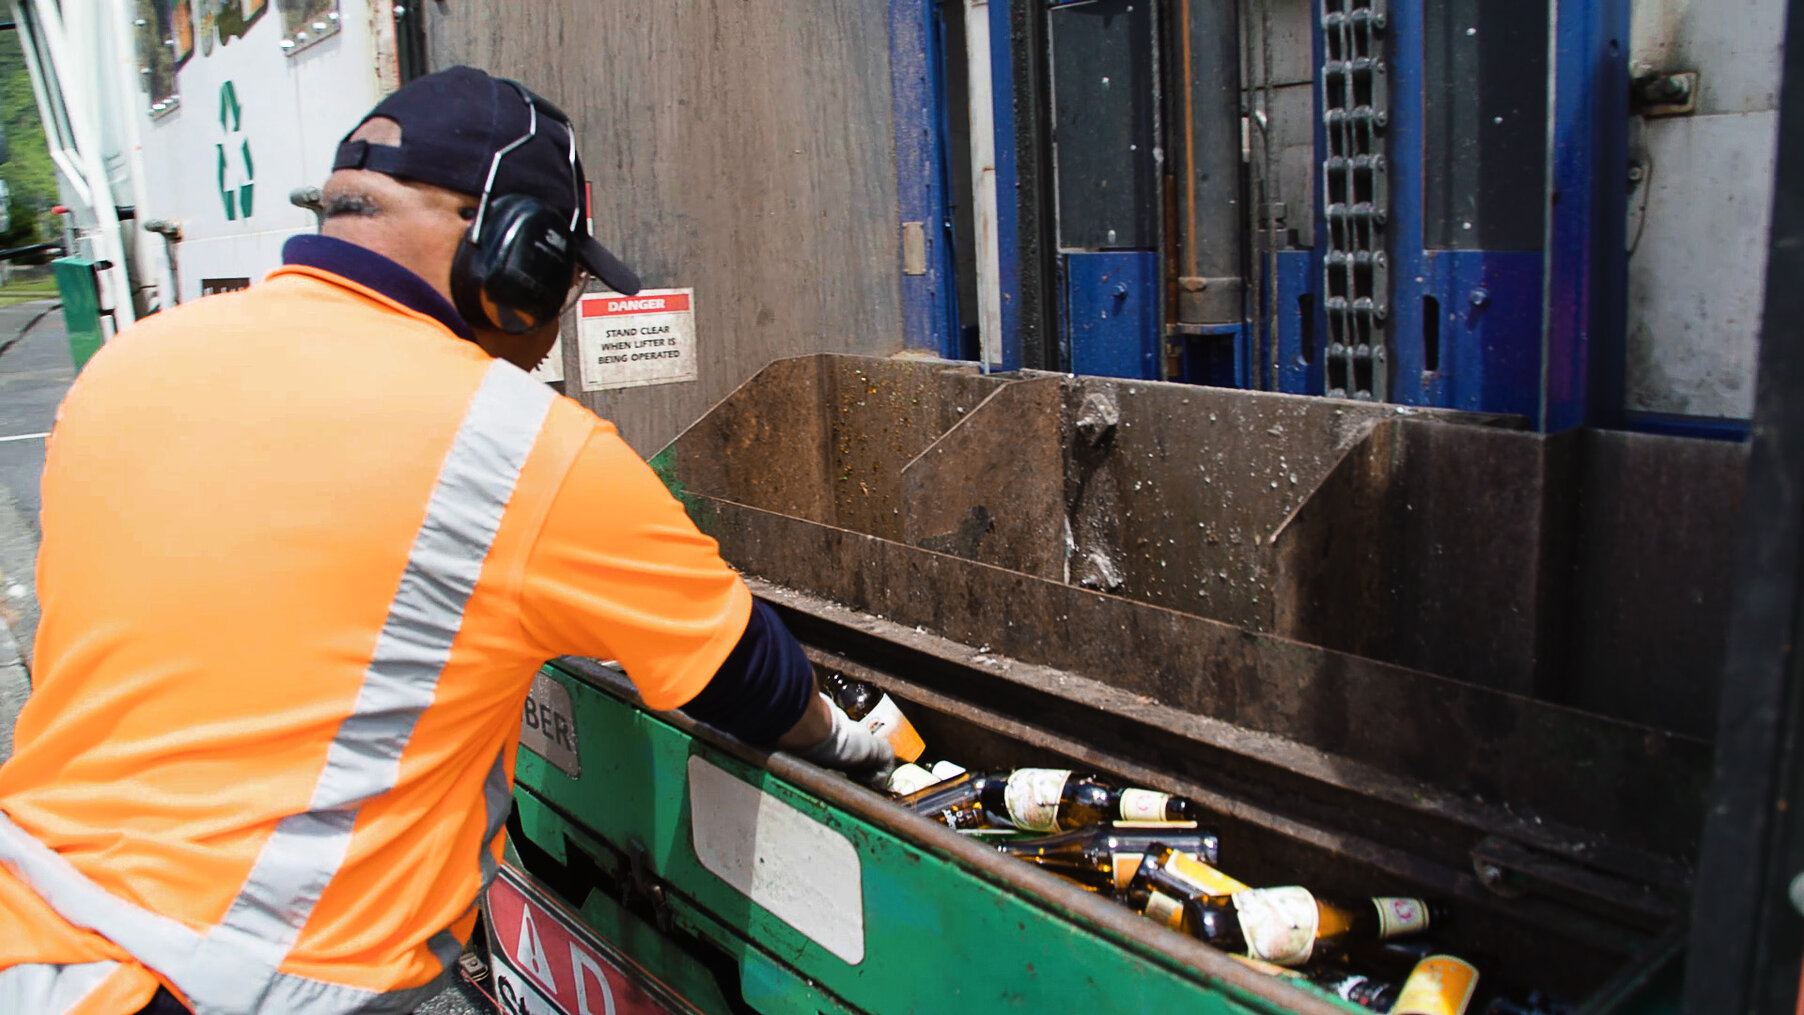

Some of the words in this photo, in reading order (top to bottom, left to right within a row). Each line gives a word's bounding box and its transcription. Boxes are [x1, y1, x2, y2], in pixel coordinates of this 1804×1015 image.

[607, 298, 666, 312] DANGER
[606, 327, 637, 338] STAND
[640, 325, 670, 336] CLEAR
[601, 340, 631, 351] WHEN
[634, 338, 665, 349] LIFTER
[668, 337, 676, 346] IS
[598, 353, 628, 365] BEING
[631, 349, 681, 362] OPERATED
